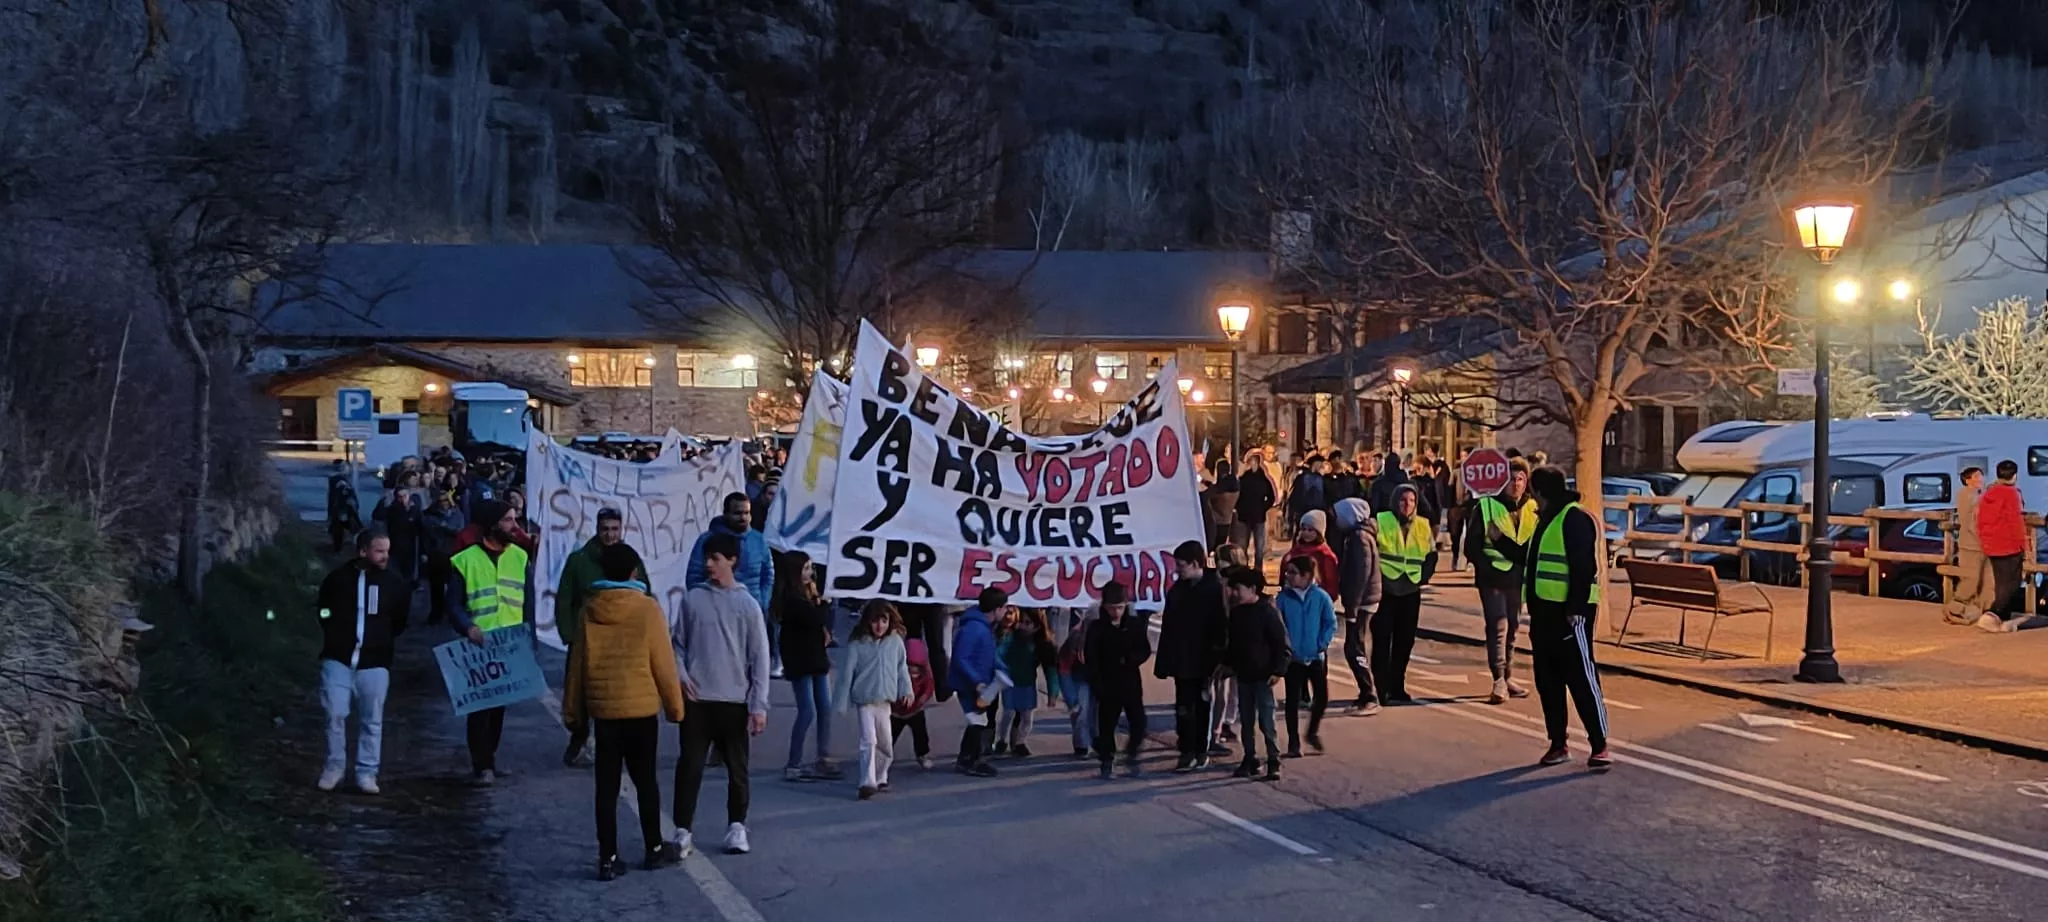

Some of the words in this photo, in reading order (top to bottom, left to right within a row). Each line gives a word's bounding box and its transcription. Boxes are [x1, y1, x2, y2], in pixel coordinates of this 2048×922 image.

[344, 392, 365, 418] P
[849, 399, 913, 474] YA
[931, 436, 1001, 500] HA
[1015, 425, 1181, 503] VOTADO
[1465, 463, 1506, 481] STOP
[862, 471, 912, 531] Y
[834, 536, 936, 598] SER
